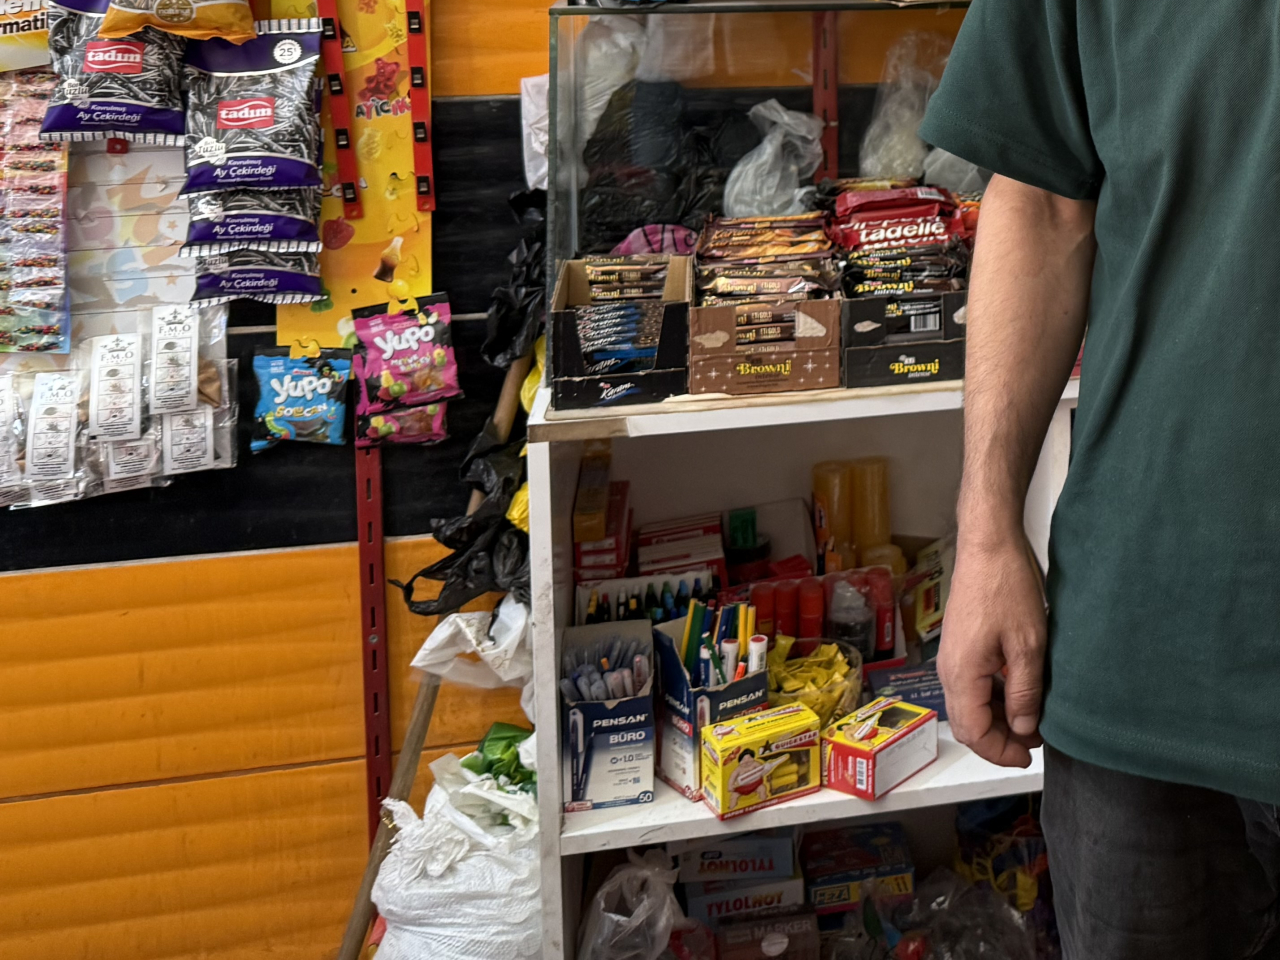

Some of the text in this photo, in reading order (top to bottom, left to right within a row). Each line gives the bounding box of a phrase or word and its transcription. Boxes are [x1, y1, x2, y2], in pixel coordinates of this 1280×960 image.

[86, 48, 141, 64] tadım
[76, 112, 142, 124] Ay Çekirdeği
[220, 105, 272, 120] tadım
[213, 165, 276, 177] Ay Çekirdeği
[212, 222, 274, 234] Ay Çekirdeği
[860, 219, 946, 242] tadelle
[220, 278, 234, 288] Ay
[718, 691, 764, 710] PENSAN
[593, 714, 645, 728] PENSAN
[609, 730, 646, 744] BÜRO
[638, 792, 653, 803] 50
